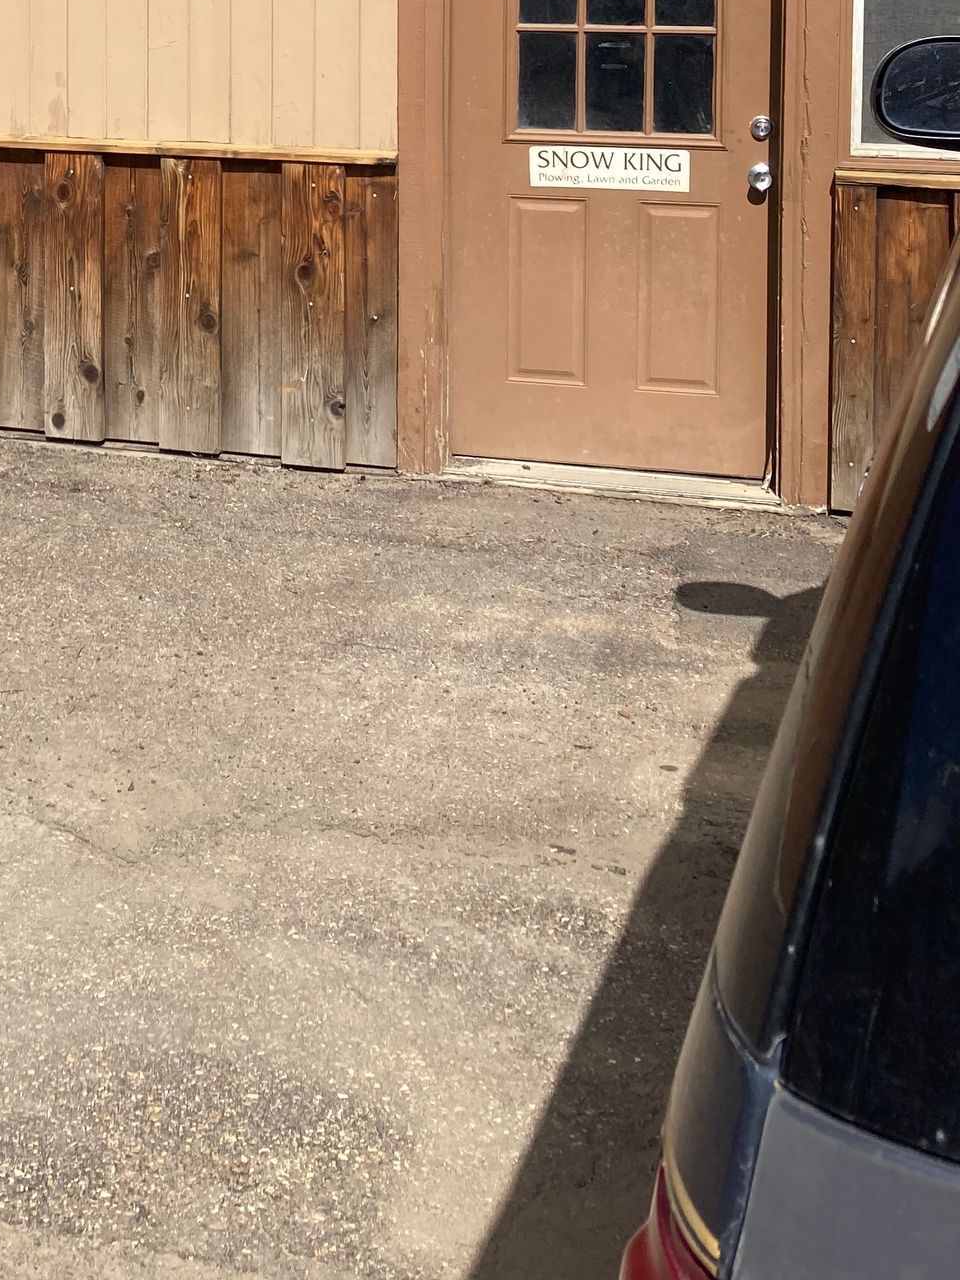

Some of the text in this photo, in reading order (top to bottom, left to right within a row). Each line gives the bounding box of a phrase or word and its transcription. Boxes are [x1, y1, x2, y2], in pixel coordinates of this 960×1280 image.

[538, 150, 682, 172] SNOW KING
[587, 174, 615, 184] Lawn
[619, 175, 638, 184] and
[642, 175, 681, 186] Garden
